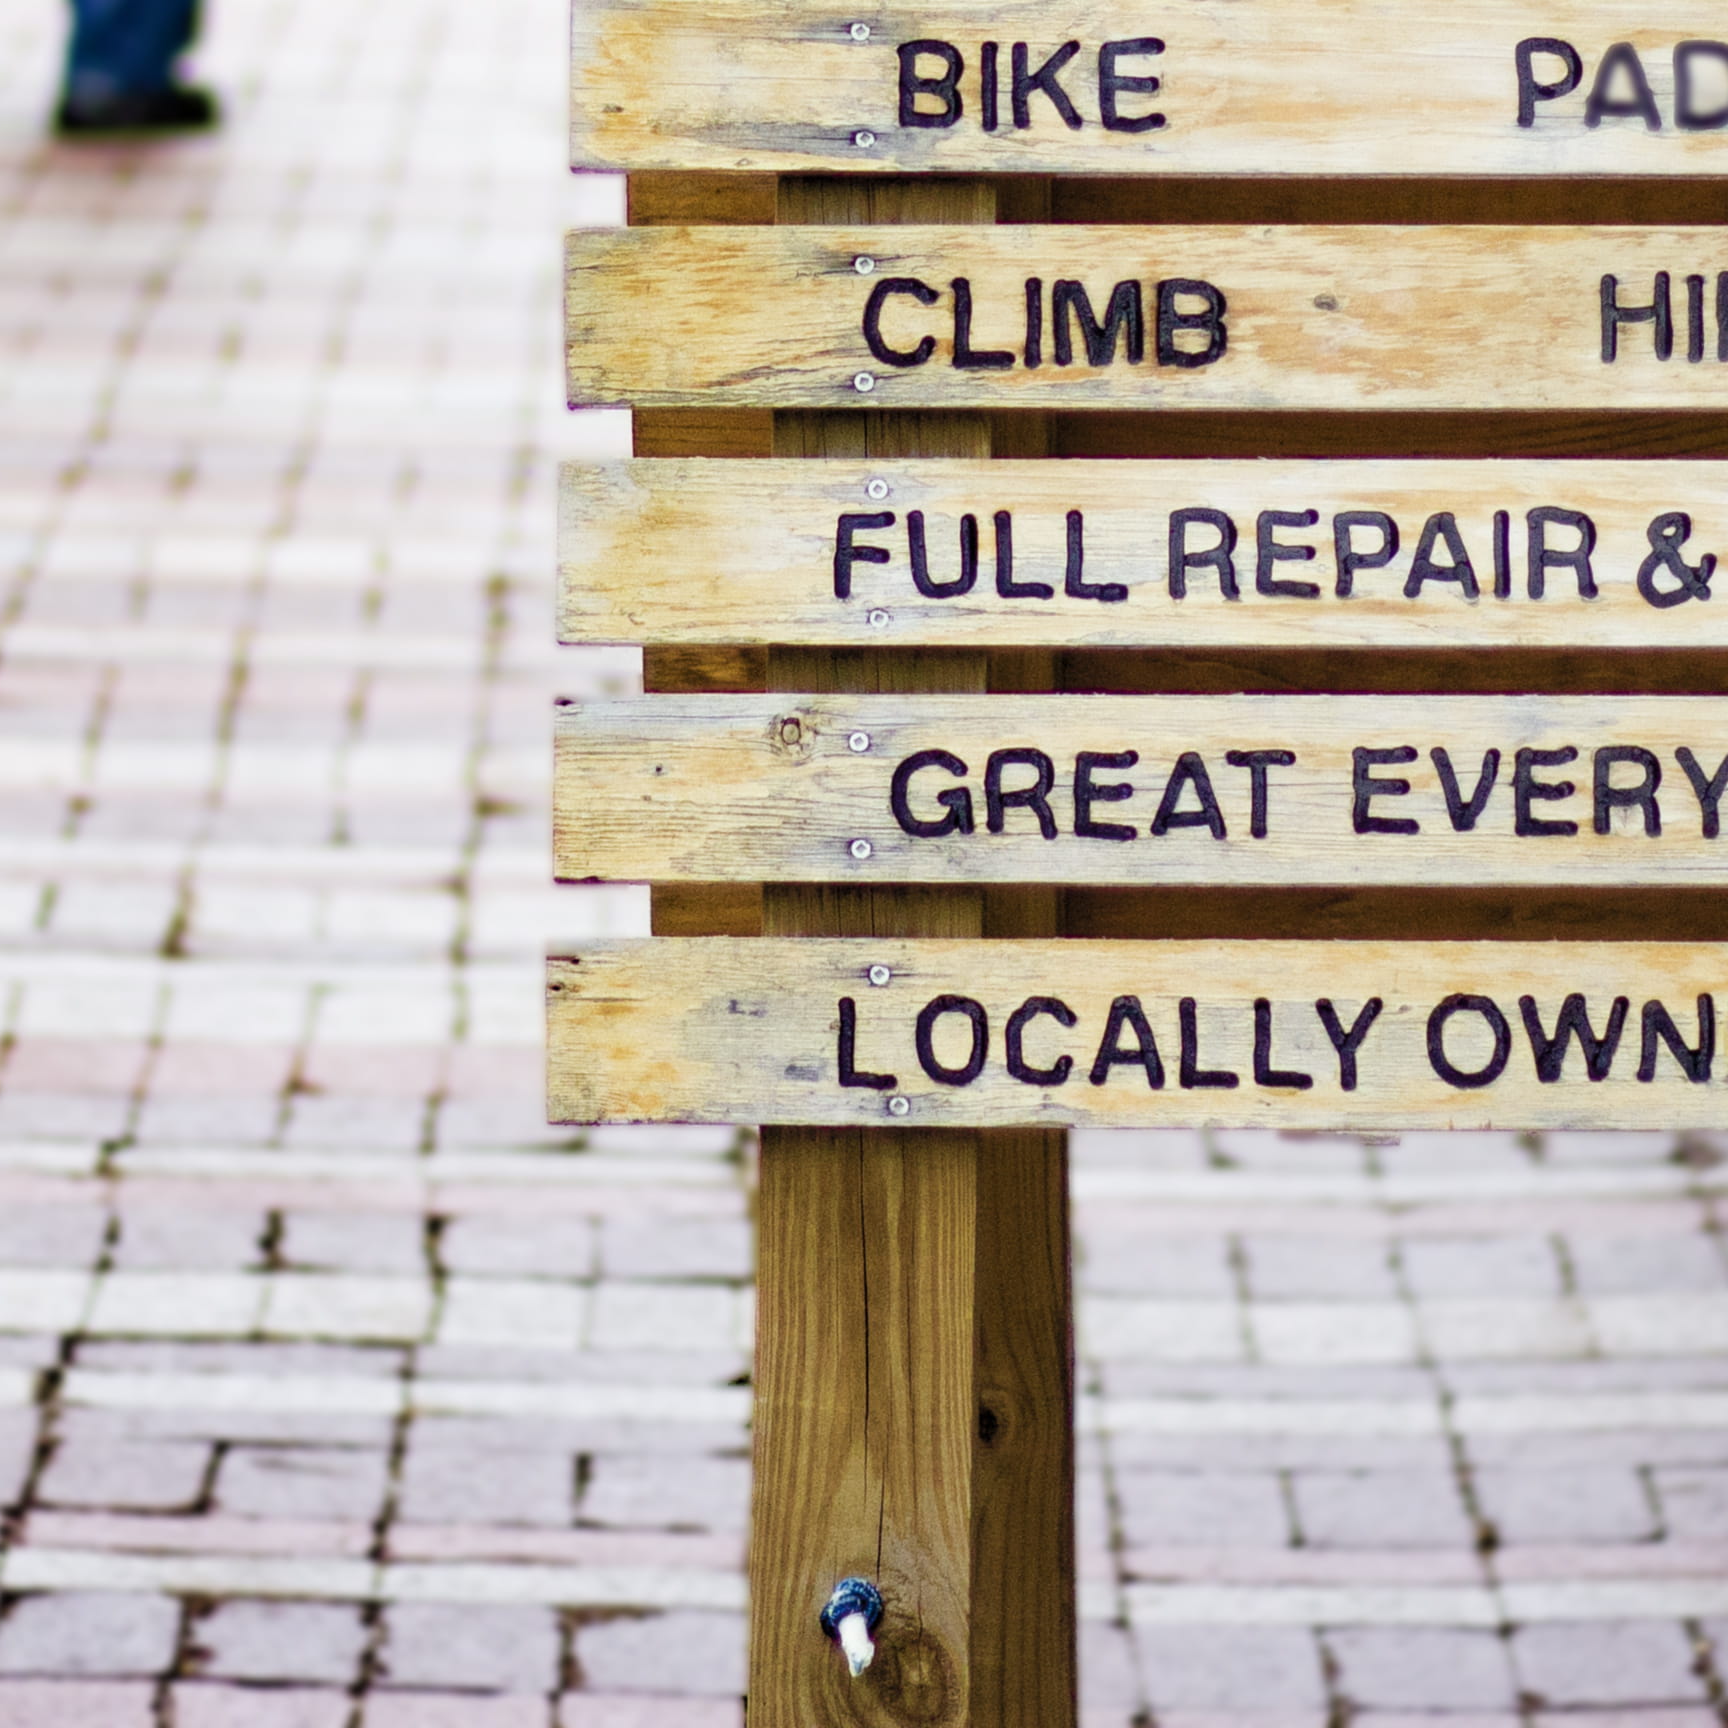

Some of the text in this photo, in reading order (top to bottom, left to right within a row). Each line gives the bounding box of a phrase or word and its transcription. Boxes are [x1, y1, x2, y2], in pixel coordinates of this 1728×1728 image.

[897, 38, 1165, 133] BIKE
[863, 277, 1228, 370] CLIMB
[834, 511, 1128, 602] FULL
[1169, 507, 1598, 600] REPAIR
[1638, 513, 1717, 608] &
[890, 748, 1295, 842] GREAT
[838, 995, 1382, 1091] LOCALLY
